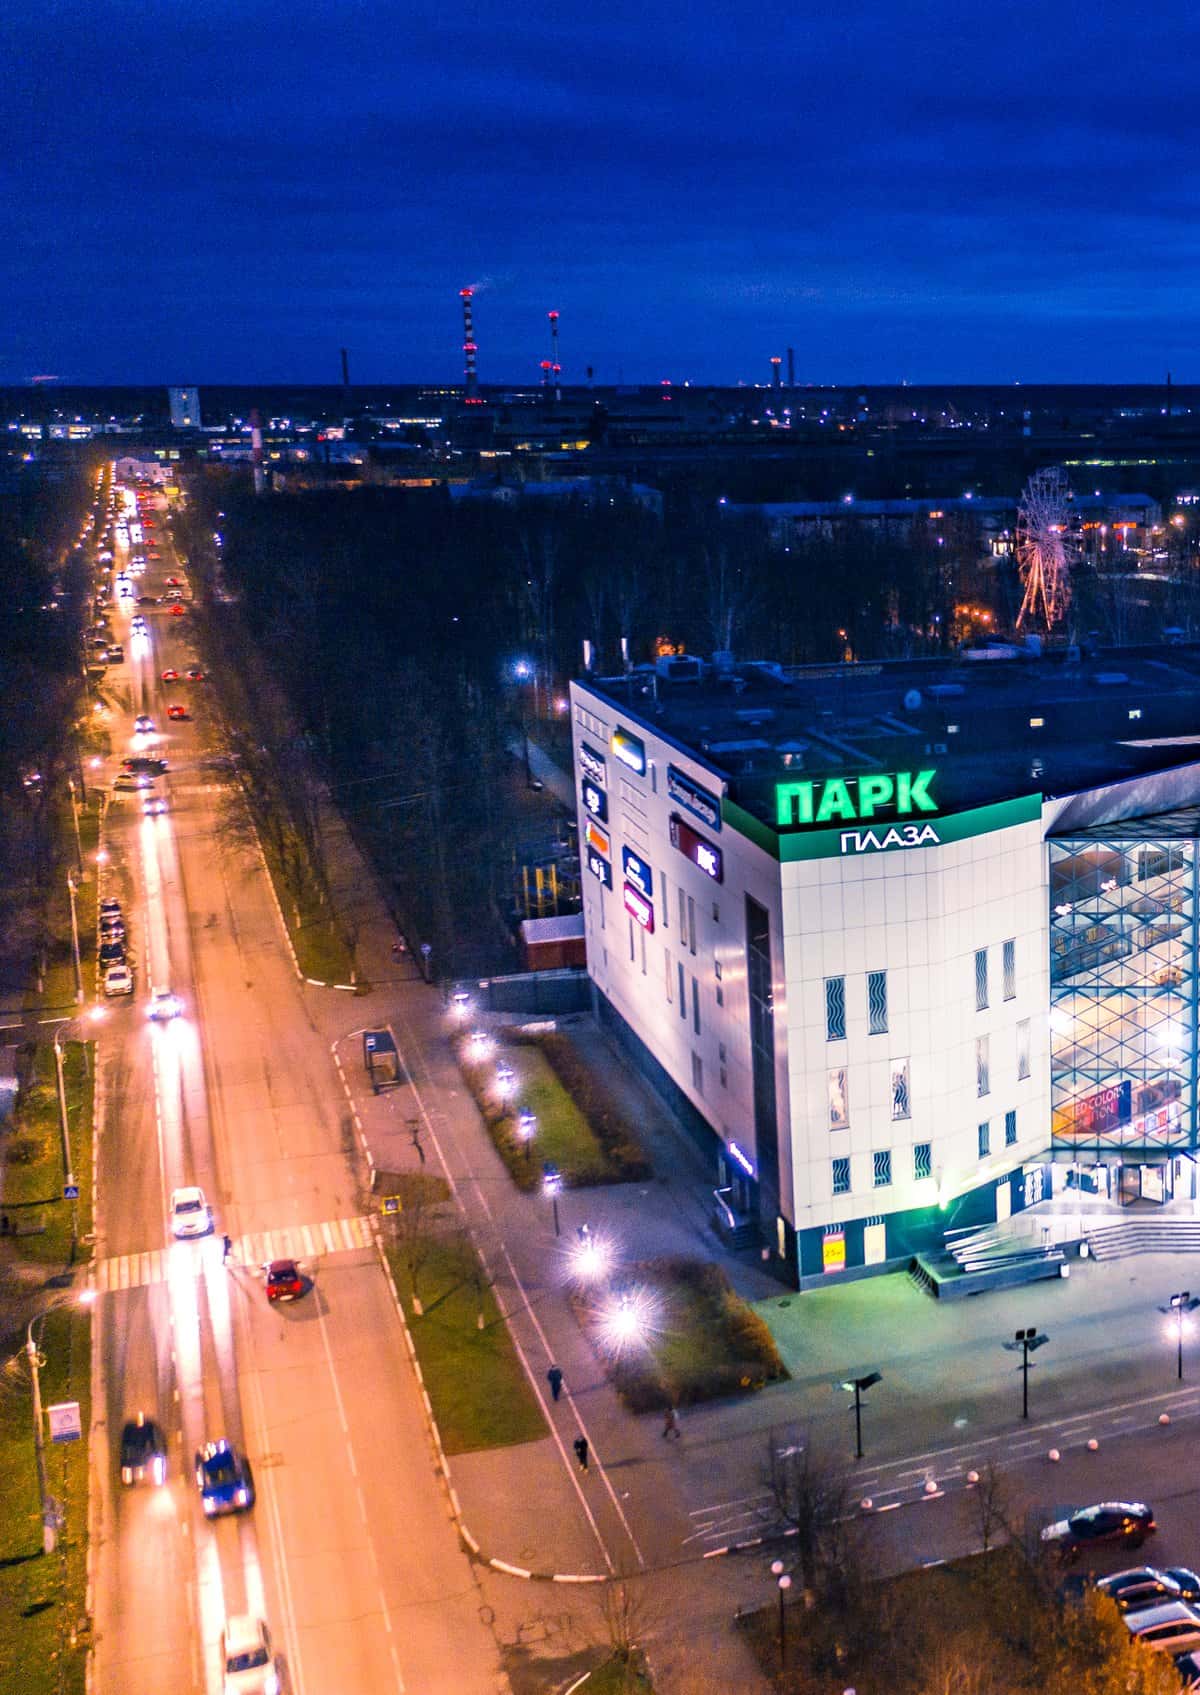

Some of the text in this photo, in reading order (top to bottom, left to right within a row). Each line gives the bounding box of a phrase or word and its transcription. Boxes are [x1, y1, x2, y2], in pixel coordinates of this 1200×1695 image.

[776, 770, 939, 825] ПАРК
[840, 824, 941, 853] ПЛАЗА
[1089, 1086, 1125, 1110] COLORS
